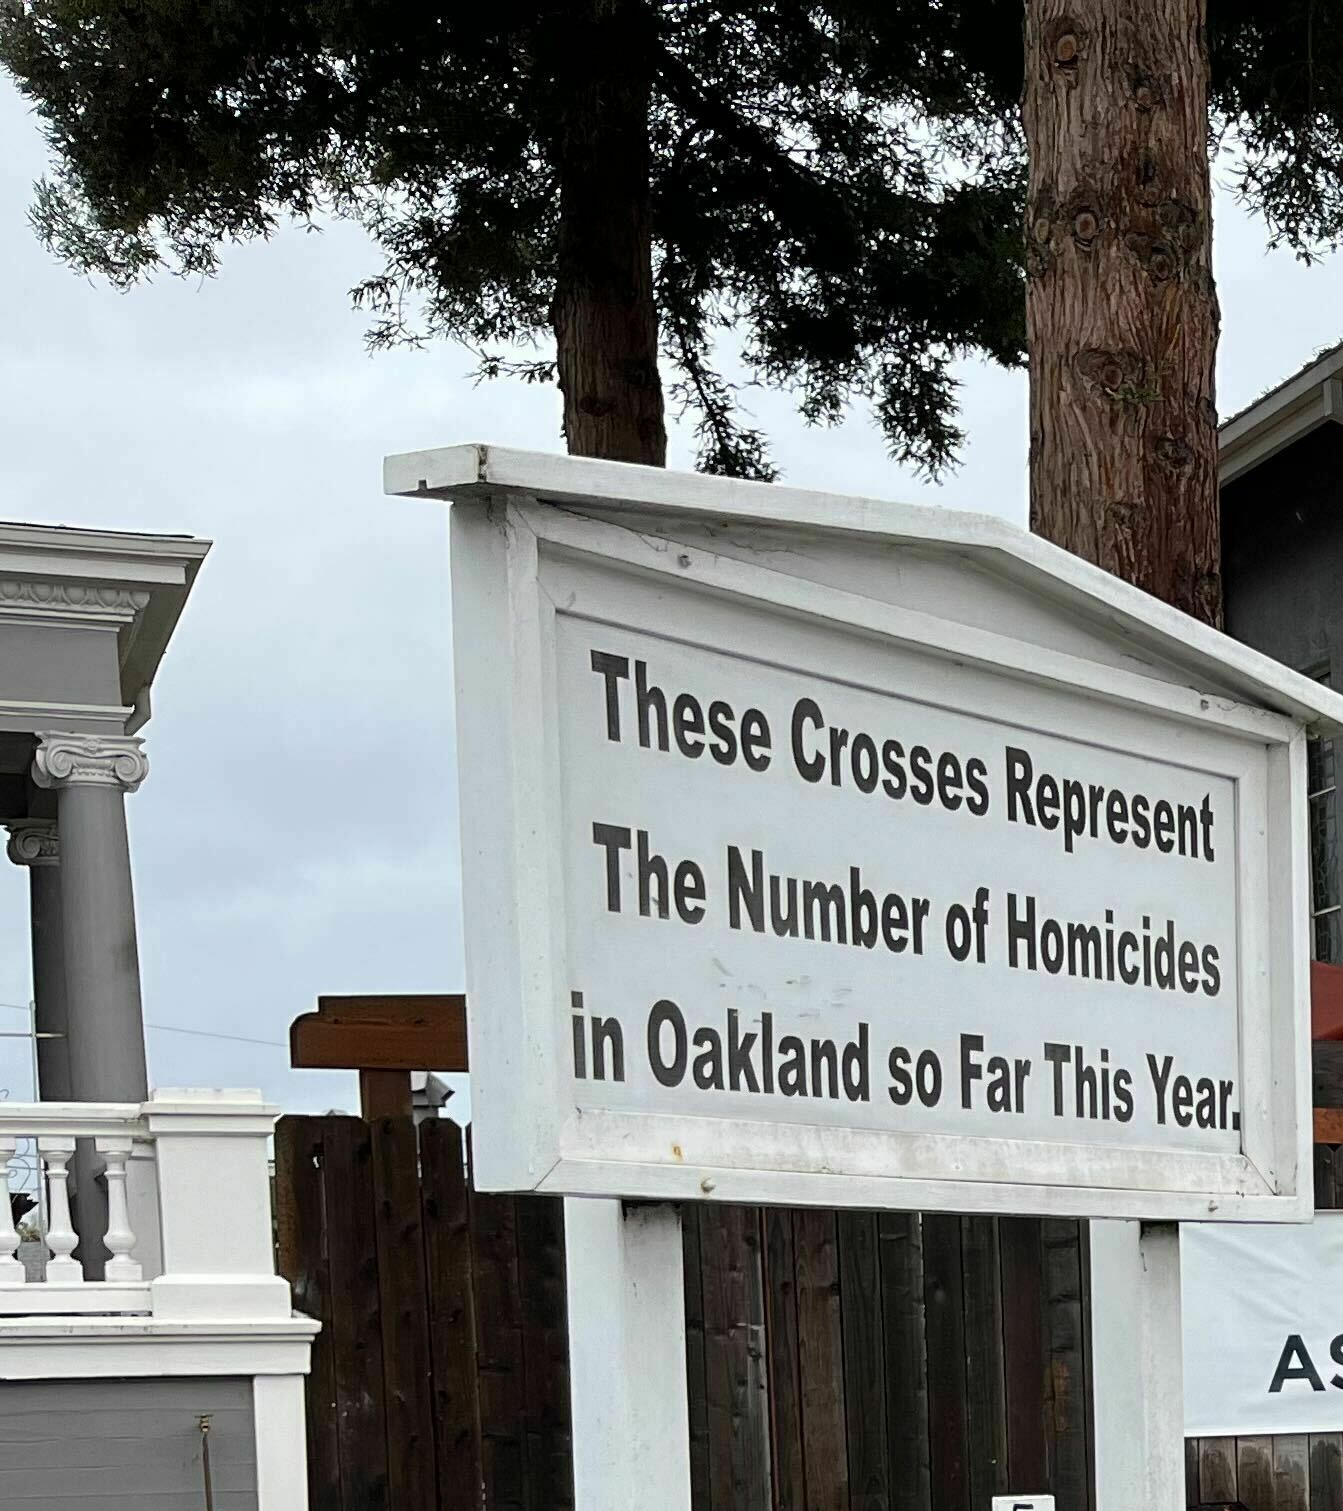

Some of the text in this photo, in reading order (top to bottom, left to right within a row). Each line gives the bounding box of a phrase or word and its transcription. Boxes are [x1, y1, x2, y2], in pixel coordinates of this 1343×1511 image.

[589, 648, 1215, 863] These Crosses Represent
[592, 821, 1221, 997] The Number of Homicides
[570, 990, 1241, 1131] in Oakland so Far This Year.
